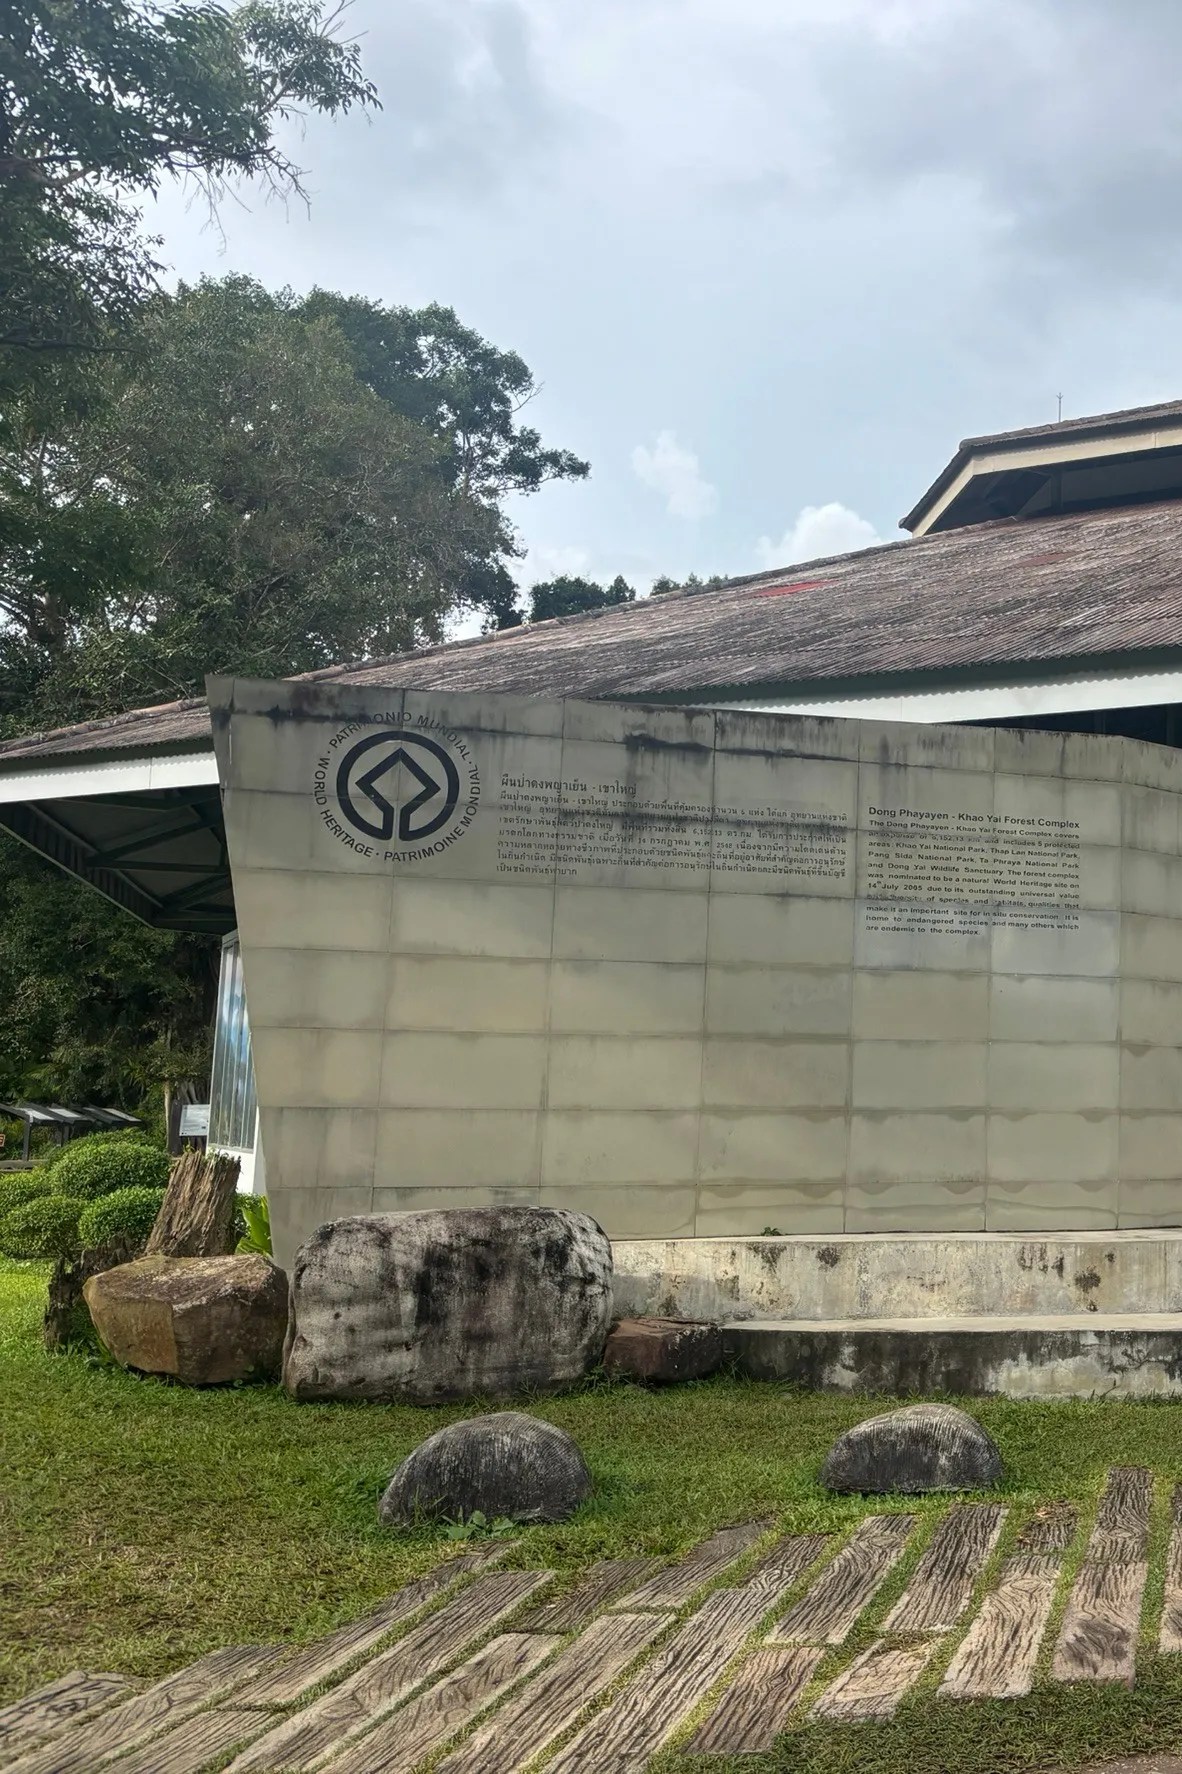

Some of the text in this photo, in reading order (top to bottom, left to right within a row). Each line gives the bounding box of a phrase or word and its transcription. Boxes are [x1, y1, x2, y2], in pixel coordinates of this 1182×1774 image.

[329, 711, 467, 761] PATRIMONIO MUNDIAL
[501, 773, 587, 794] ผืนป่าดงพญาเย็น
[599, 779, 637, 798] เขาใหญ่
[313, 756, 374, 858] WORLD HERITAGE
[384, 764, 481, 862] PATRIMOINE MONDIAL
[578, 795, 609, 808] เขาใหญ่
[749, 807, 764, 816] แห่ง
[868, 807, 896, 818] Dong
[899, 808, 949, 821] Phayayen
[958, 812, 984, 822] Khao
[986, 814, 1001, 823] Yai
[1004, 815, 1036, 826] Forest
[1037, 818, 1080, 829] Complex
[869, 819, 884, 827] The
[886, 821, 908, 829] Dong
[910, 822, 949, 831] Phayayen
[956, 825, 977, 833] Khao
[992, 827, 1017, 836] Forest
[1018, 829, 1052, 838] Complex
[933, 844, 966, 852] National
[990, 847, 1010, 855] Thap
[1027, 850, 1059, 858] National
[1044, 841, 1080, 850] protected
[868, 851, 890, 859] Pang
[894, 852, 913, 860] Sida
[993, 858, 1021, 866] Phraya
[1025, 860, 1058, 868] National
[887, 863, 910, 871] Dong
[930, 865, 960, 873] Wildlife
[1023, 870, 1046, 878] forest
[1047, 872, 1080, 880] complex
[888, 873, 931, 881] nominated
[993, 878, 1017, 886] World
[1019, 880, 1052, 888] Heritage
[881, 883, 899, 891] July
[968, 888, 1016, 897] outstanding
[1019, 890, 1055, 898] universal
[910, 907, 949, 915] important
[880, 925, 916, 933] endemic
[906, 917, 954, 925] endangered
[958, 919, 989, 927] species
[1007, 921, 1029, 929] many
